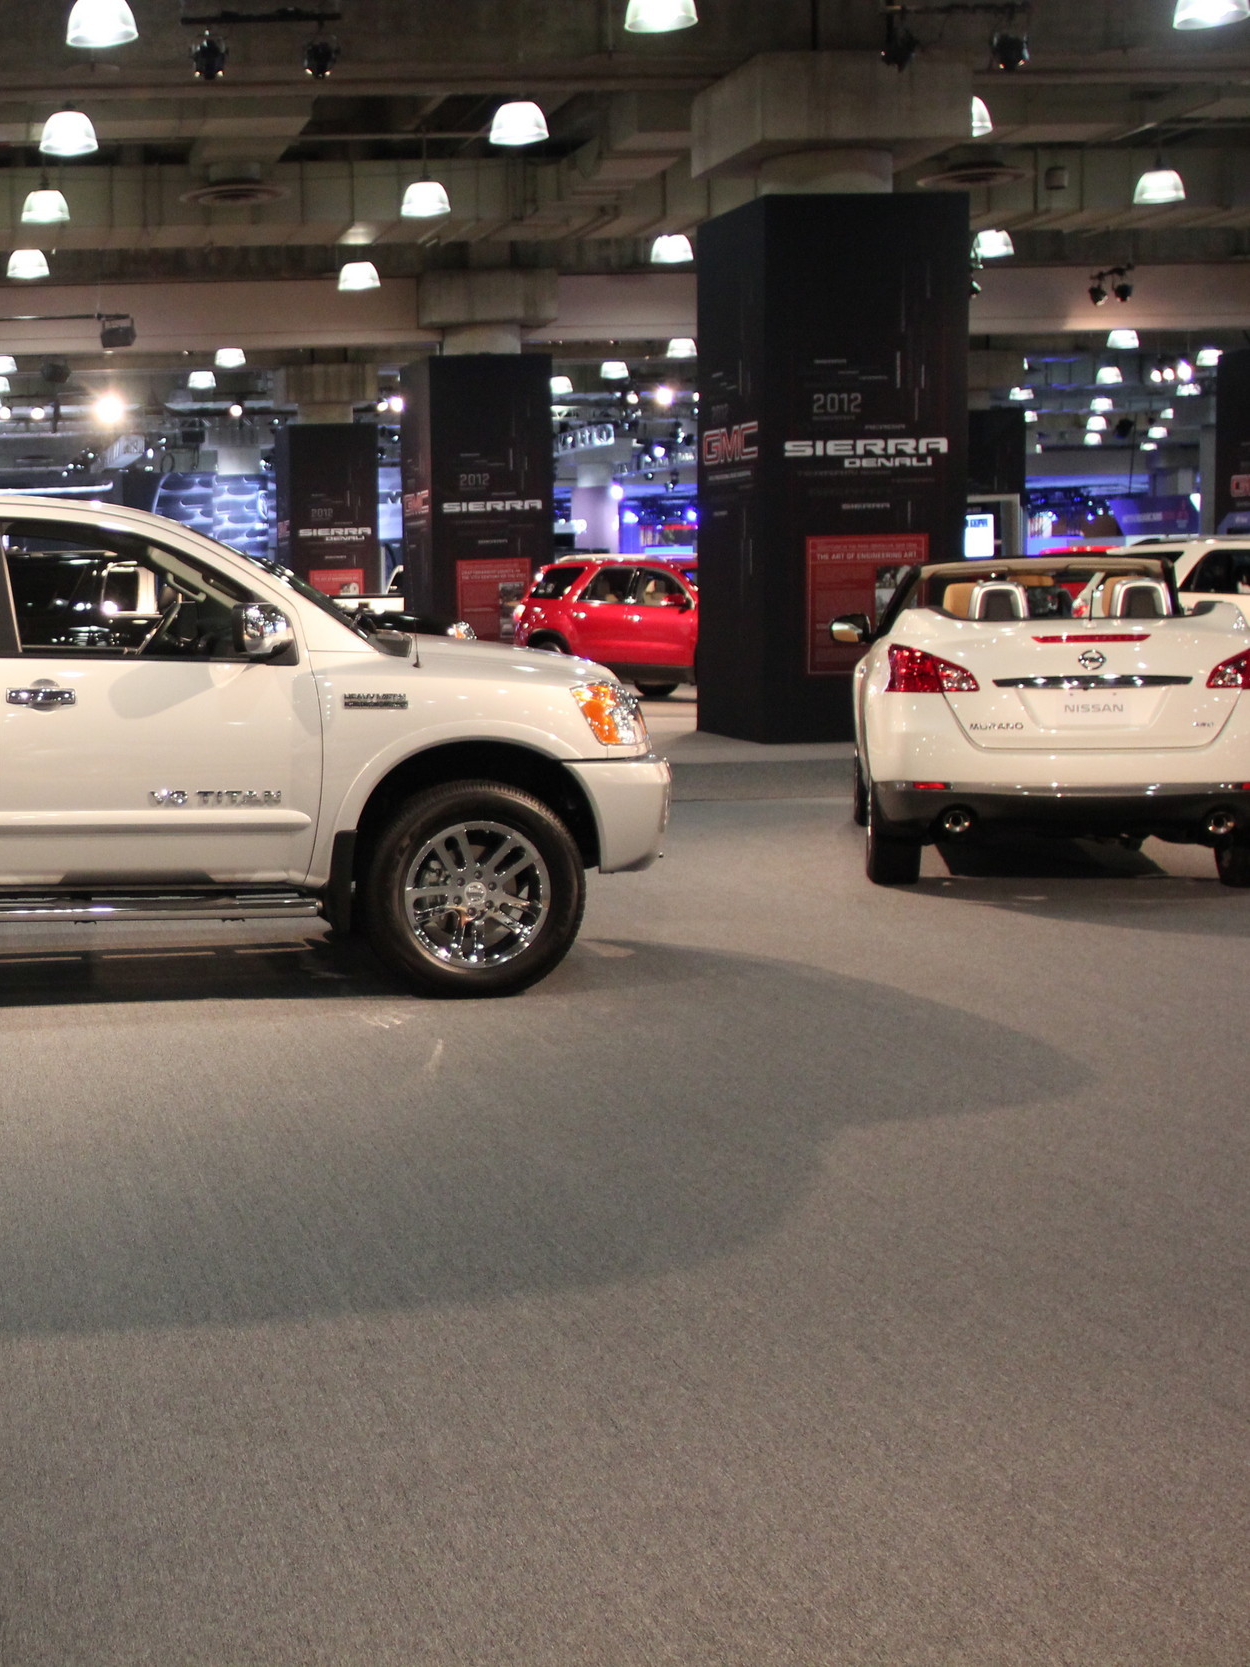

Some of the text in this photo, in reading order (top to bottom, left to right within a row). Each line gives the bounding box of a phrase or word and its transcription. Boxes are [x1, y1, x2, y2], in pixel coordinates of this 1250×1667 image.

[813, 393, 862, 413] 2012
[703, 420, 759, 467] GMC
[784, 437, 949, 457] SIERRA
[844, 456, 932, 468] DENALI
[459, 473, 490, 486] 2012
[442, 499, 543, 513] SIERRA
[298, 527, 372, 537] SIERRA
[1064, 703, 1124, 713] NISSAN
[969, 722, 1024, 731] MURANO
[196, 790, 282, 806] TITAN
